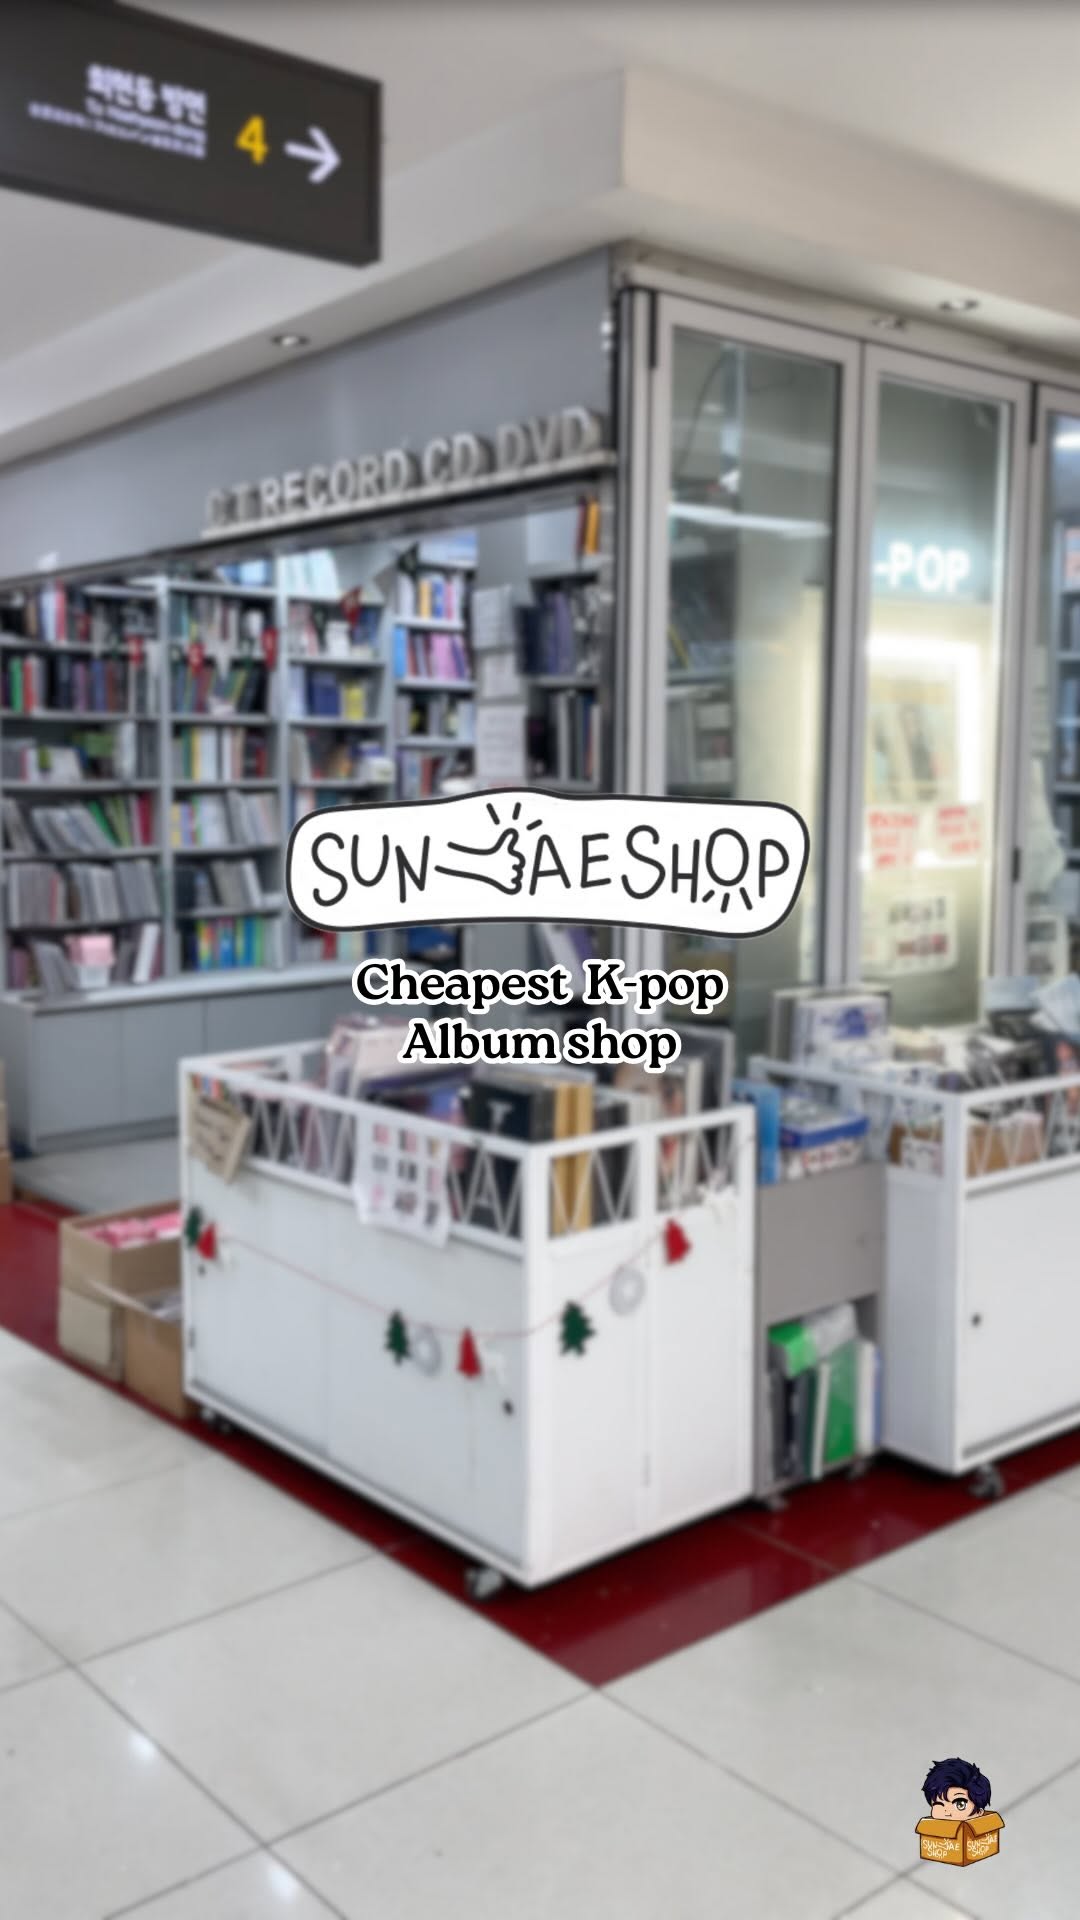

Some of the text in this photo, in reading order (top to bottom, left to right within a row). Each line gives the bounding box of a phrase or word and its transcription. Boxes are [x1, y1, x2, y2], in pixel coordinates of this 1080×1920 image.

[235, 115, 267, 164] 4
[257, 448, 410, 517] RECORD
[423, 431, 482, 487] CD
[497, 405, 595, 470] DVD
